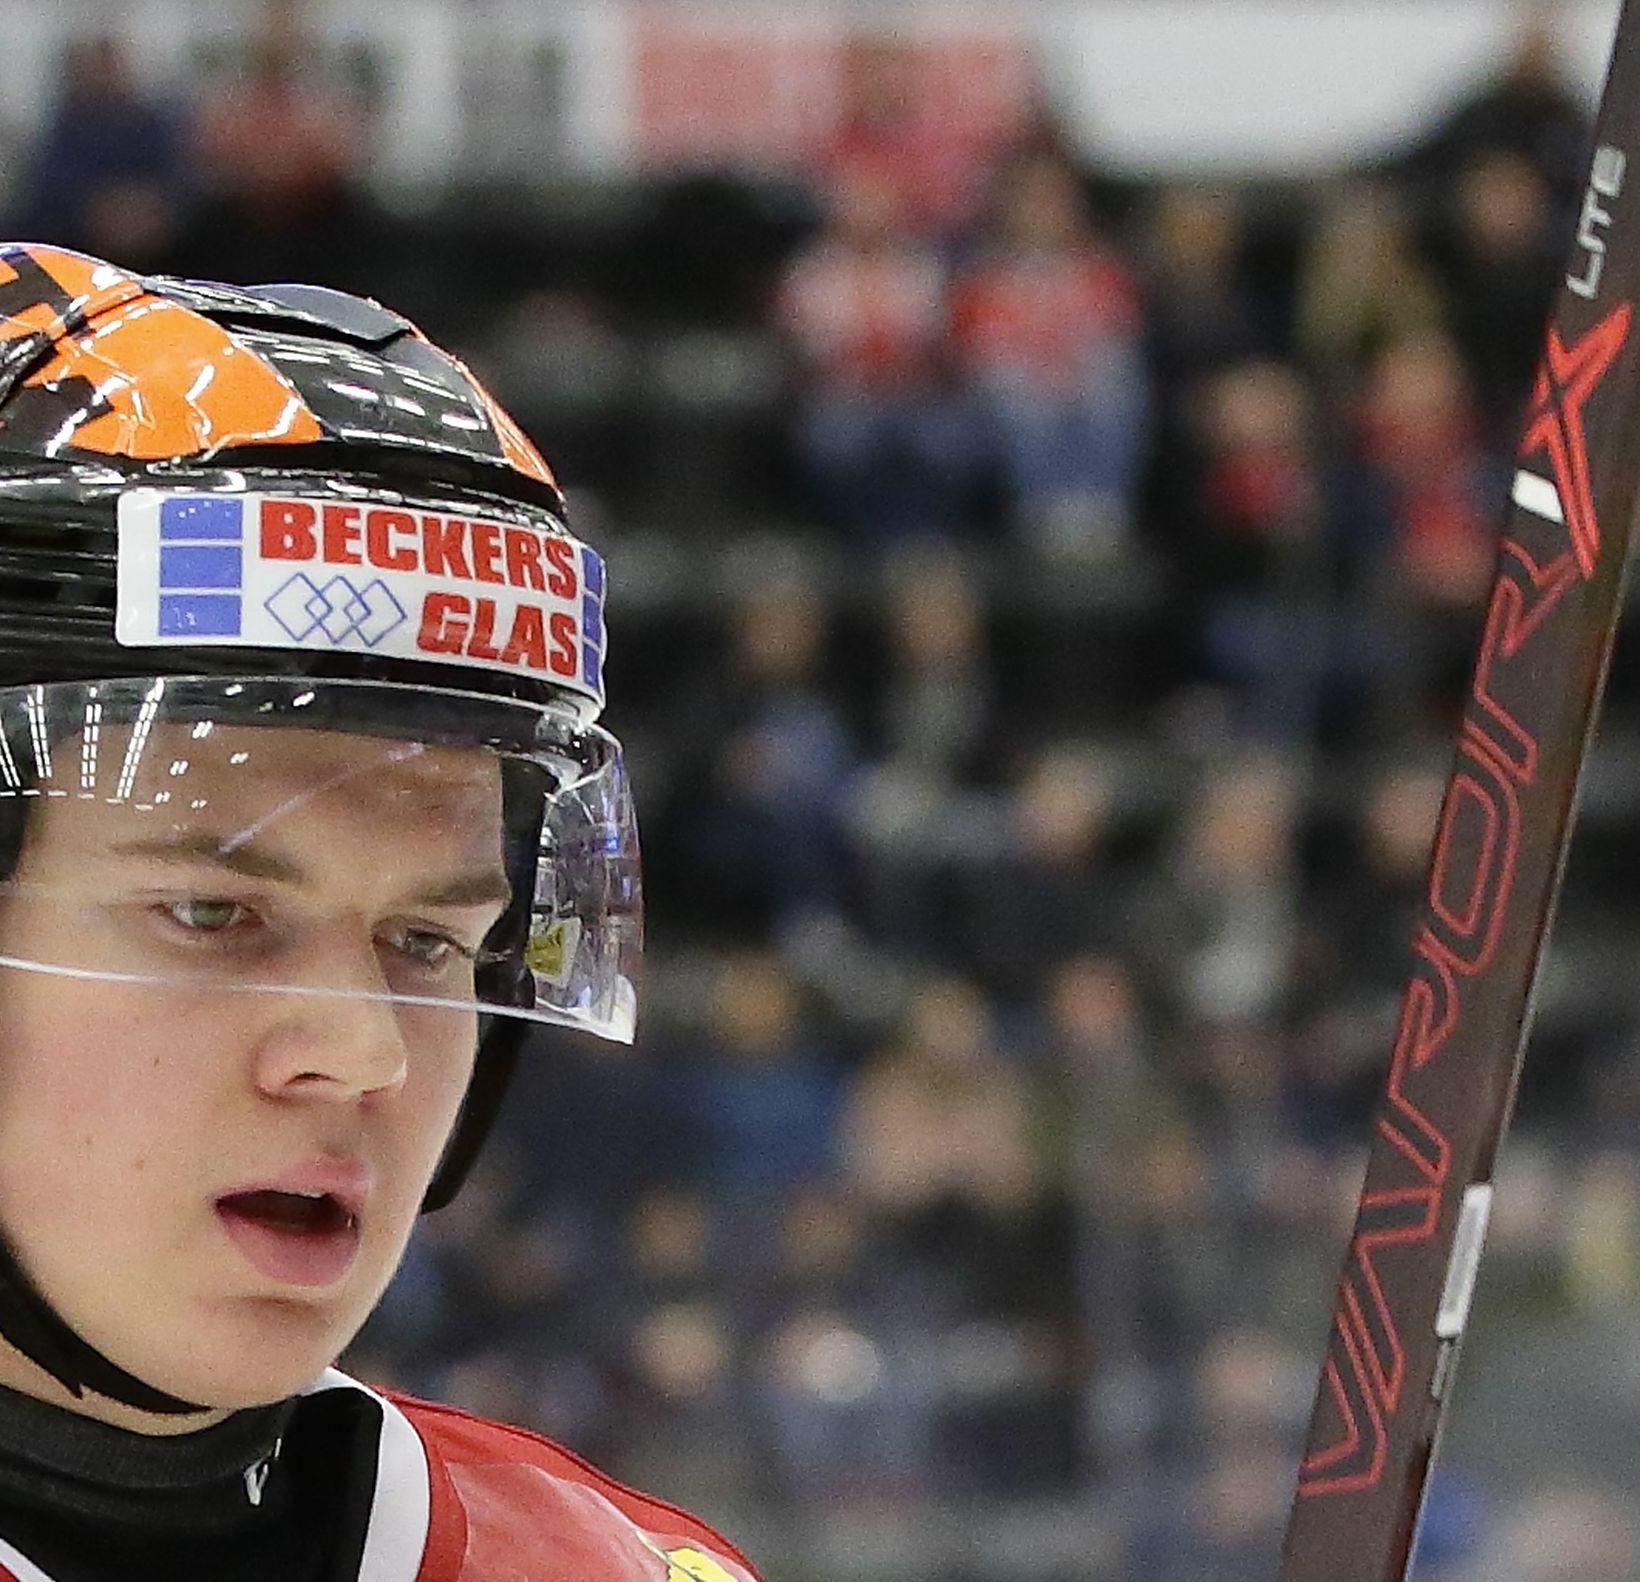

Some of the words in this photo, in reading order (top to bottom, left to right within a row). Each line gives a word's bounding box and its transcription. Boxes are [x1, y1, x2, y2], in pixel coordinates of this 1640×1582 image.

[1566, 146, 1627, 299] LITE
[260, 500, 578, 600] BECKERS
[416, 591, 578, 678] GLAS
